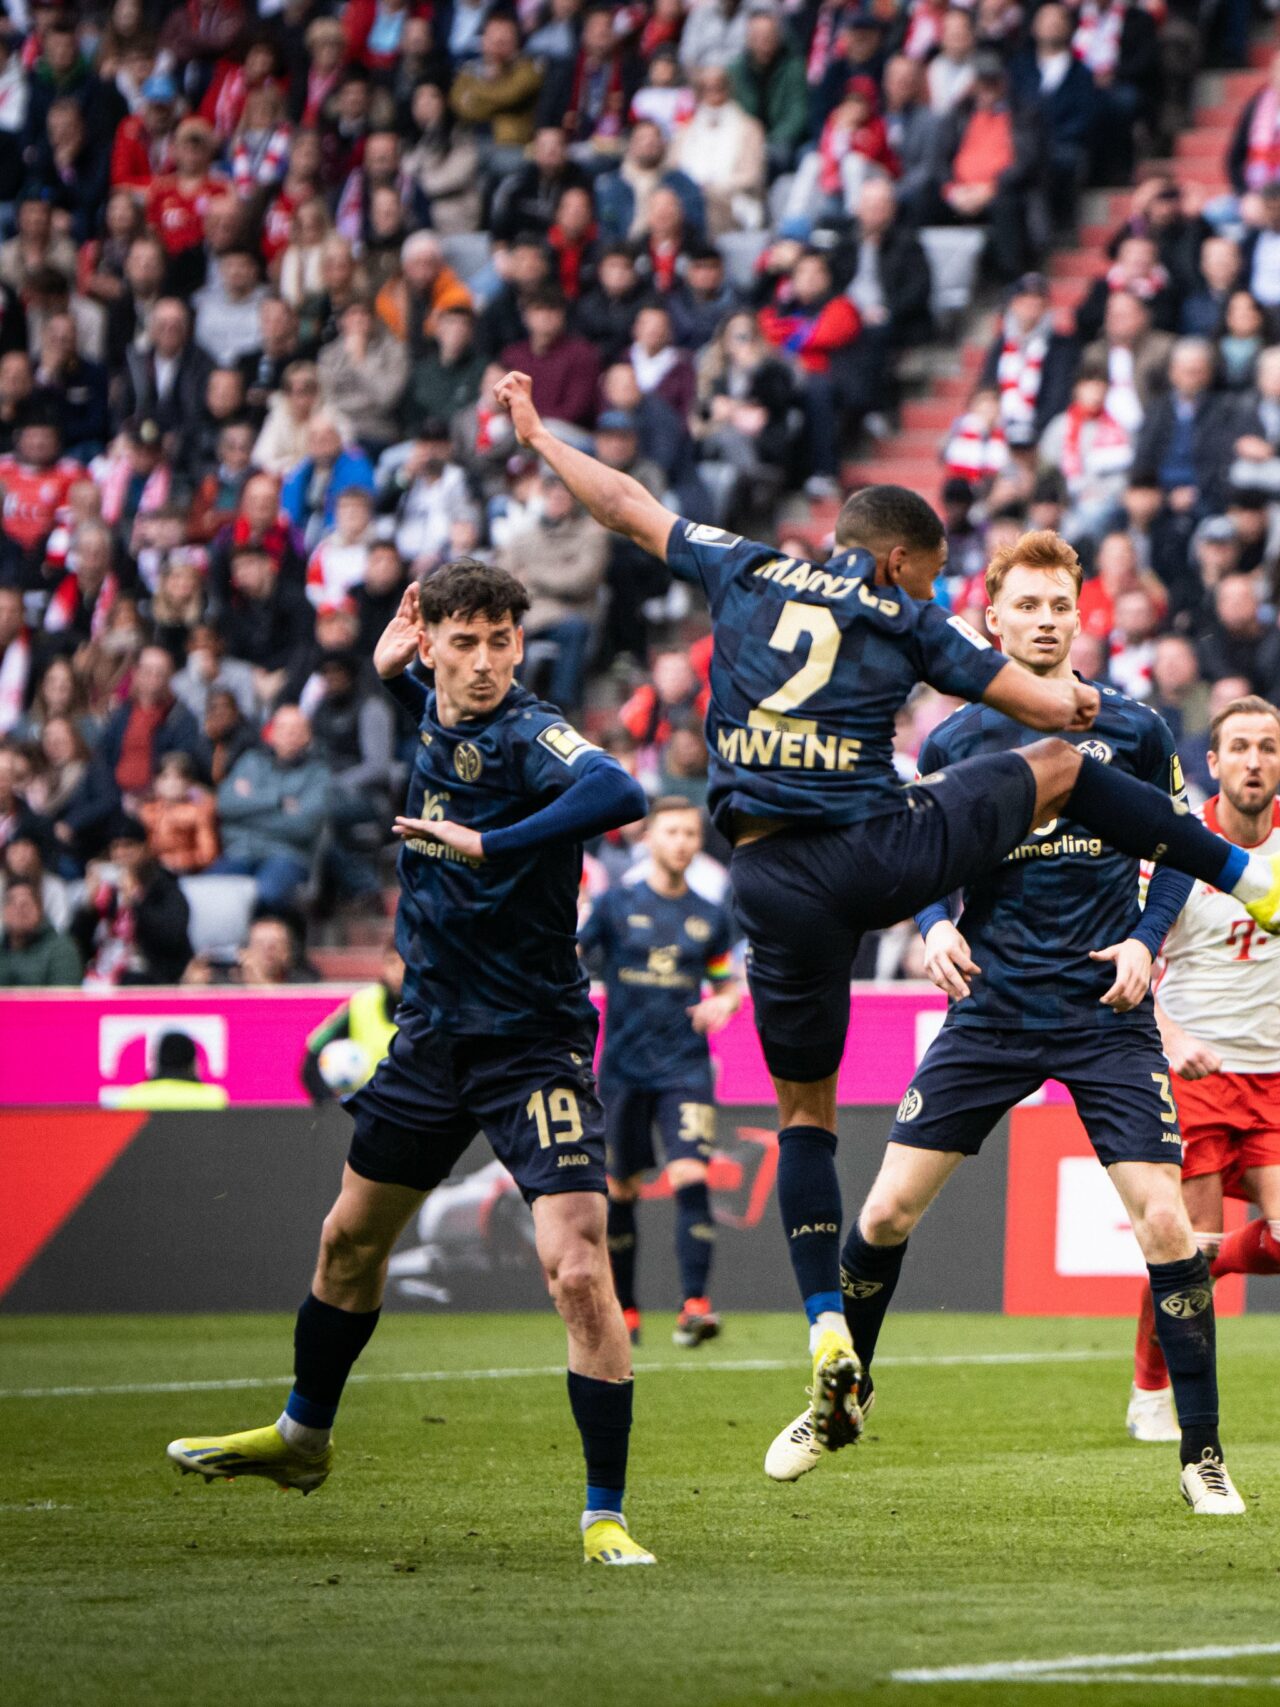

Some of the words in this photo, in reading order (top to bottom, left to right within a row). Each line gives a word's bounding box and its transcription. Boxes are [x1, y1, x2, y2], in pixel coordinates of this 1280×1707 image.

[748, 600, 842, 735] 2
[717, 728, 863, 772] MWENE
[526, 1087, 583, 1149] 19
[1151, 1072, 1177, 1124] 3
[557, 1153, 589, 1168] JAKO
[1161, 1132, 1182, 1145] JAK
[790, 1222, 838, 1239] JAKO
